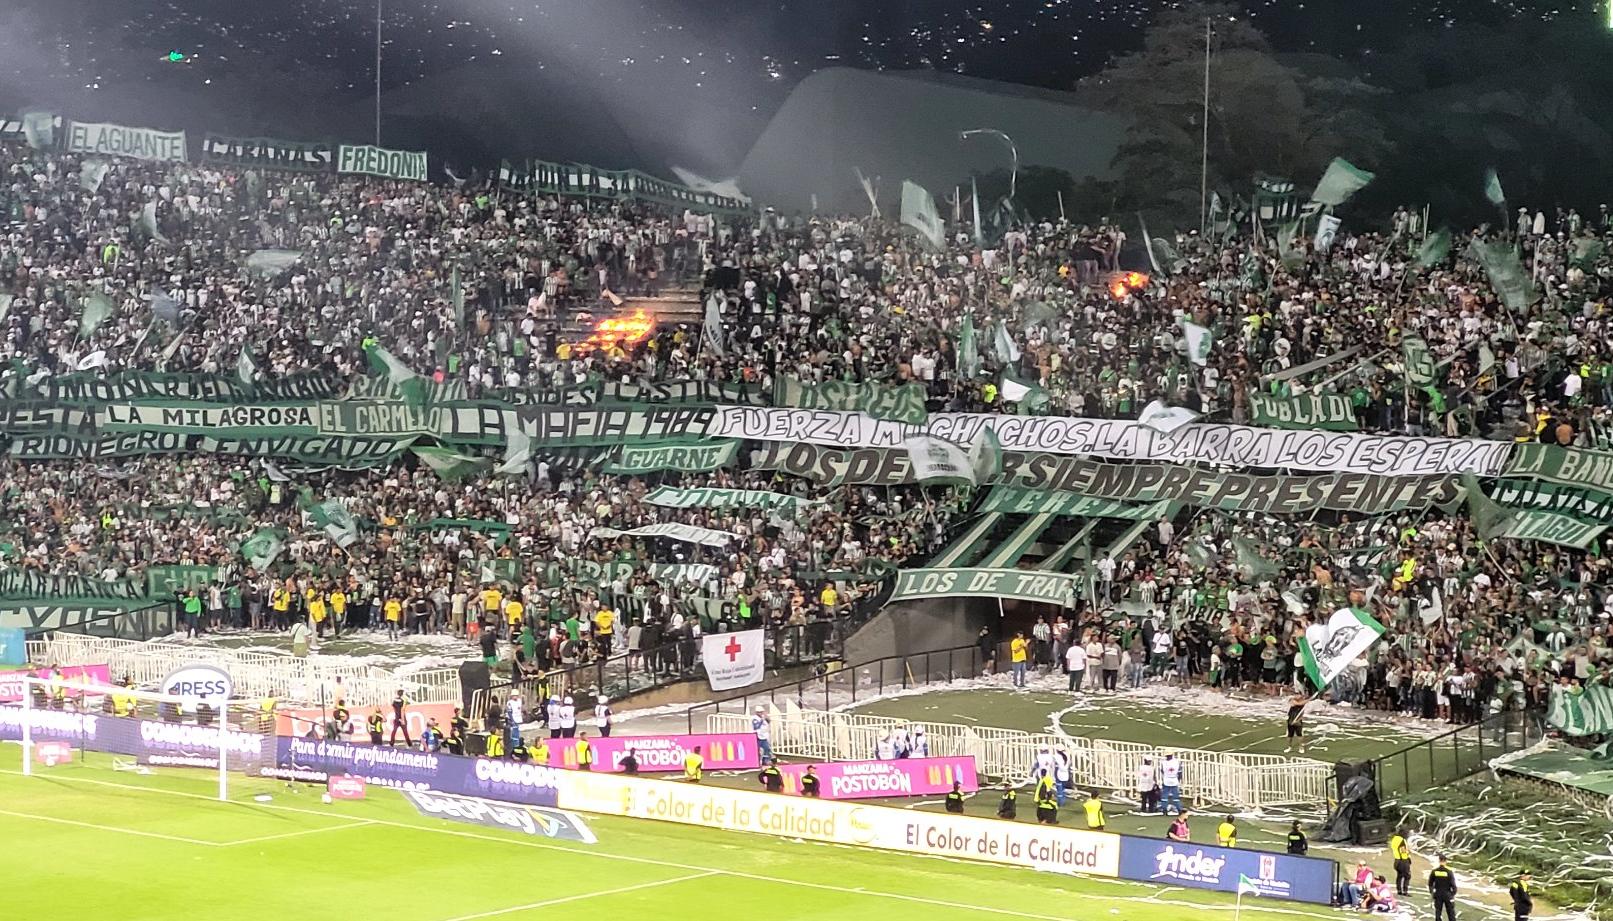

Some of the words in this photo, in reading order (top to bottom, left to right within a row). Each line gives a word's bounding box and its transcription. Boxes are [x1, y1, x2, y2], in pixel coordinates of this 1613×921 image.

[72, 127, 95, 150] EL
[97, 128, 183, 158] AGUANTE
[341, 146, 426, 180] FREDONIA
[107, 405, 142, 424] LA
[162, 406, 312, 427] MILAGROSA
[320, 404, 347, 432] EL
[355, 404, 441, 433] CARMELO
[452, 405, 505, 439] LA
[517, 405, 631, 444] MAFIA
[640, 405, 718, 440] 1989
[1252, 393, 1355, 425] POBLADO
[20, 430, 181, 458] RIONEGRO
[215, 434, 397, 460] ENVIGADO
[723, 408, 862, 445] FUERZA
[1149, 428, 1263, 463] BARRA
[1275, 433, 1352, 468] LOS
[626, 446, 722, 469] GUARNE
[757, 442, 838, 485] LOS
[844, 447, 914, 486] DE
[1512, 444, 1548, 472] LA
[1021, 453, 1216, 503] SIEMPRE
[1214, 473, 1461, 512] PRESENTES
[902, 572, 958, 596] LOS
[967, 572, 1006, 593] DE
[291, 737, 316, 756] Para
[353, 745, 438, 771] profundamente
[842, 764, 890, 775] MANZANA
[832, 769, 911, 797] POSTOBÓN
[412, 790, 537, 835] BetPlay
[702, 800, 726, 825] de
[730, 802, 750, 826] la
[758, 805, 835, 837] Calidad
[906, 823, 920, 846] El
[926, 825, 970, 853] Color
[977, 830, 1000, 855] de
[1005, 833, 1022, 857] la
[1027, 838, 1099, 870] Calidad
